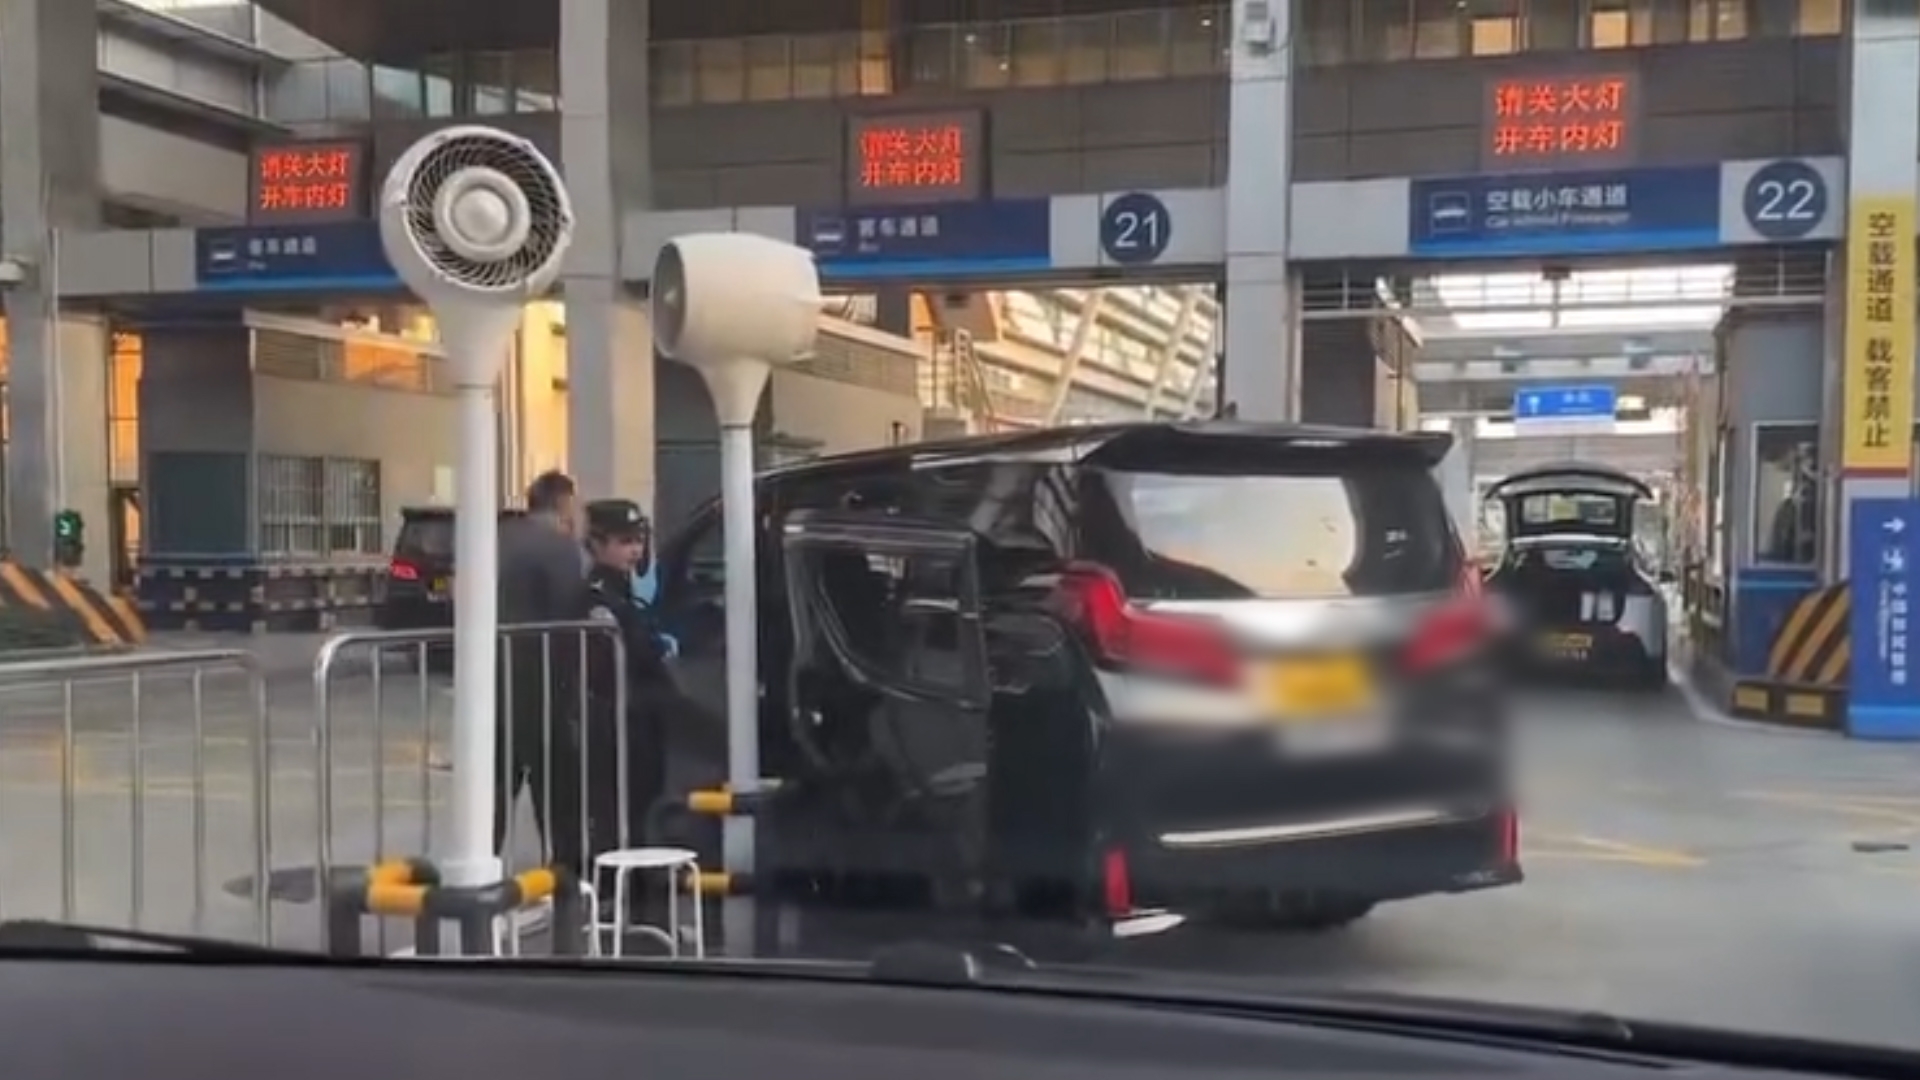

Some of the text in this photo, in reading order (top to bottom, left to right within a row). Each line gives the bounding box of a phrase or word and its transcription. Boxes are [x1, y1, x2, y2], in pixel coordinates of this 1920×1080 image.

[1495, 120, 1625, 154] 开车内灯
[860, 158, 961, 187] 开车内灯
[1486, 183, 1627, 211] 空载小车通道
[1757, 179, 1815, 219] 22
[1115, 210, 1156, 247] 21
[1863, 211, 1896, 447] 空载通道 载客禁止
